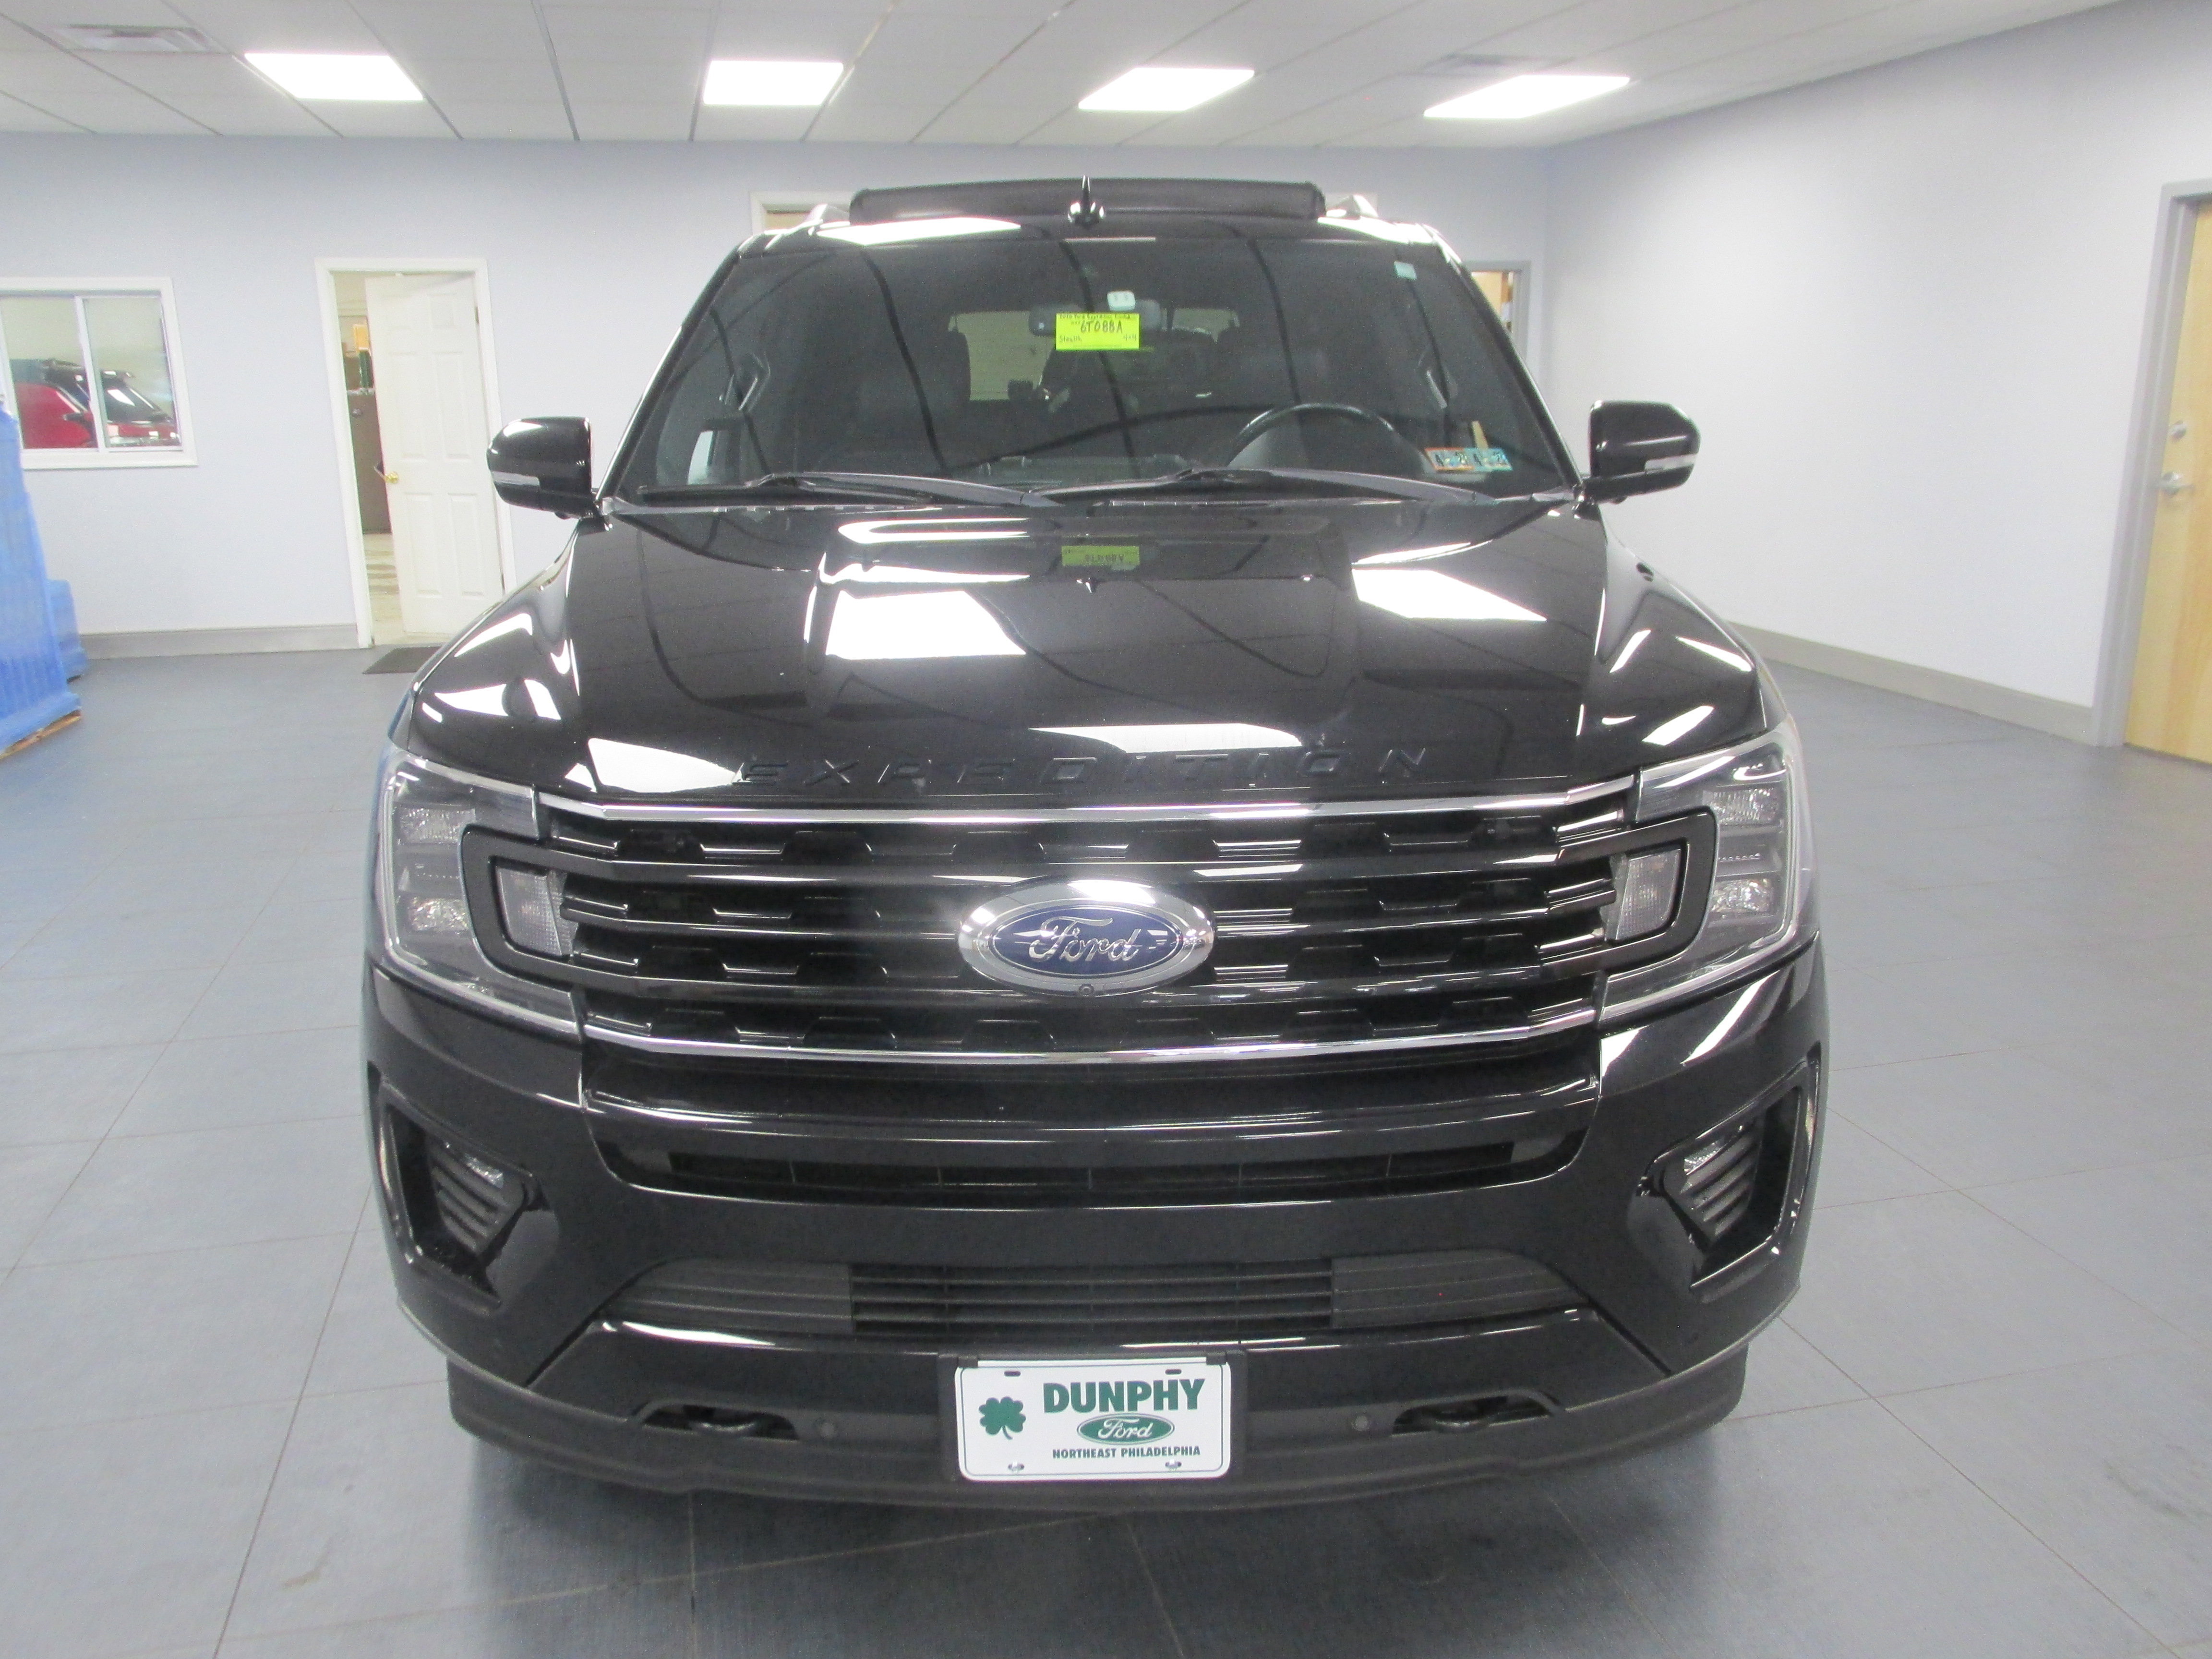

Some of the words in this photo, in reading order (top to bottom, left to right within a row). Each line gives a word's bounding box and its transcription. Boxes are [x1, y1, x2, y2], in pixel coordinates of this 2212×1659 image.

[734, 747, 1426, 786] EXPEDITION
[1028, 916, 1142, 962] Ford
[1043, 1379, 1205, 1414] DUNPHY
[1097, 1417, 1154, 1440] Ford
[1052, 1448, 1117, 1459] NORTHEAST
[1120, 1445, 1201, 1458] PHILADELPHIA
